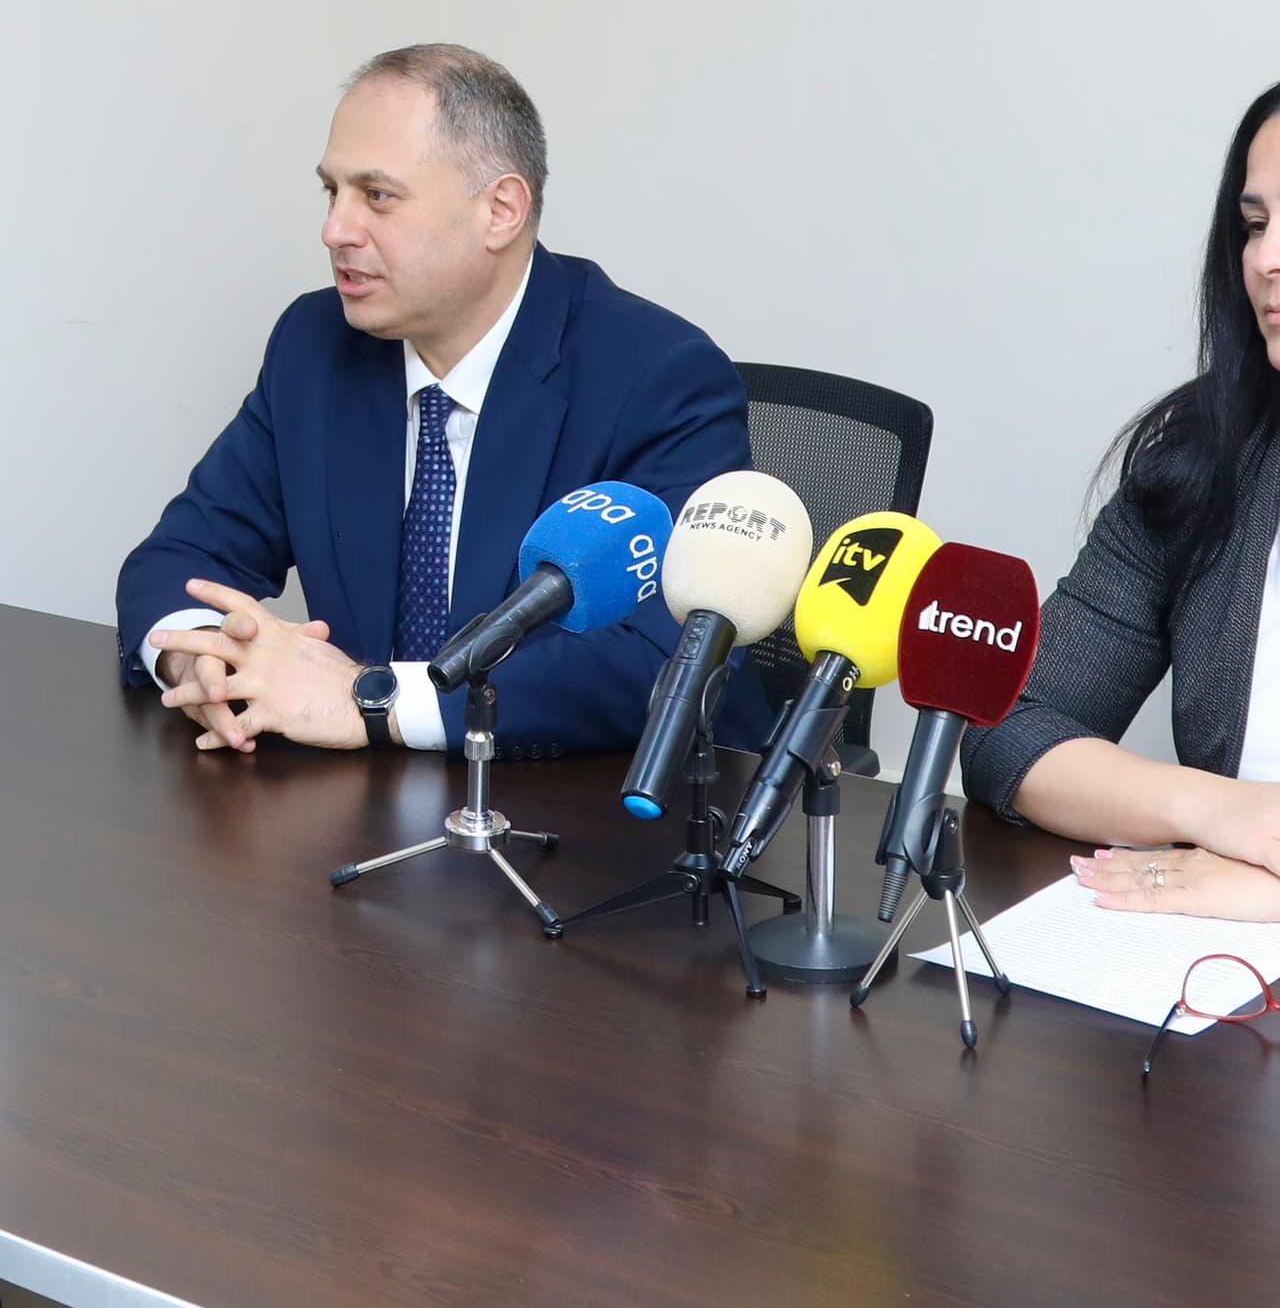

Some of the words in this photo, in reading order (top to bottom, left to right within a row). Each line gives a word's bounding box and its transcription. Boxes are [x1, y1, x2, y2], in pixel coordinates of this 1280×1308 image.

[561, 489, 636, 524] apa
[680, 502, 787, 541] REPORT
[690, 522, 717, 532] NEWS
[719, 523, 762, 542] AGENCY
[626, 534, 658, 603] apa
[832, 538, 886, 572] itv
[919, 600, 1023, 653] trend
